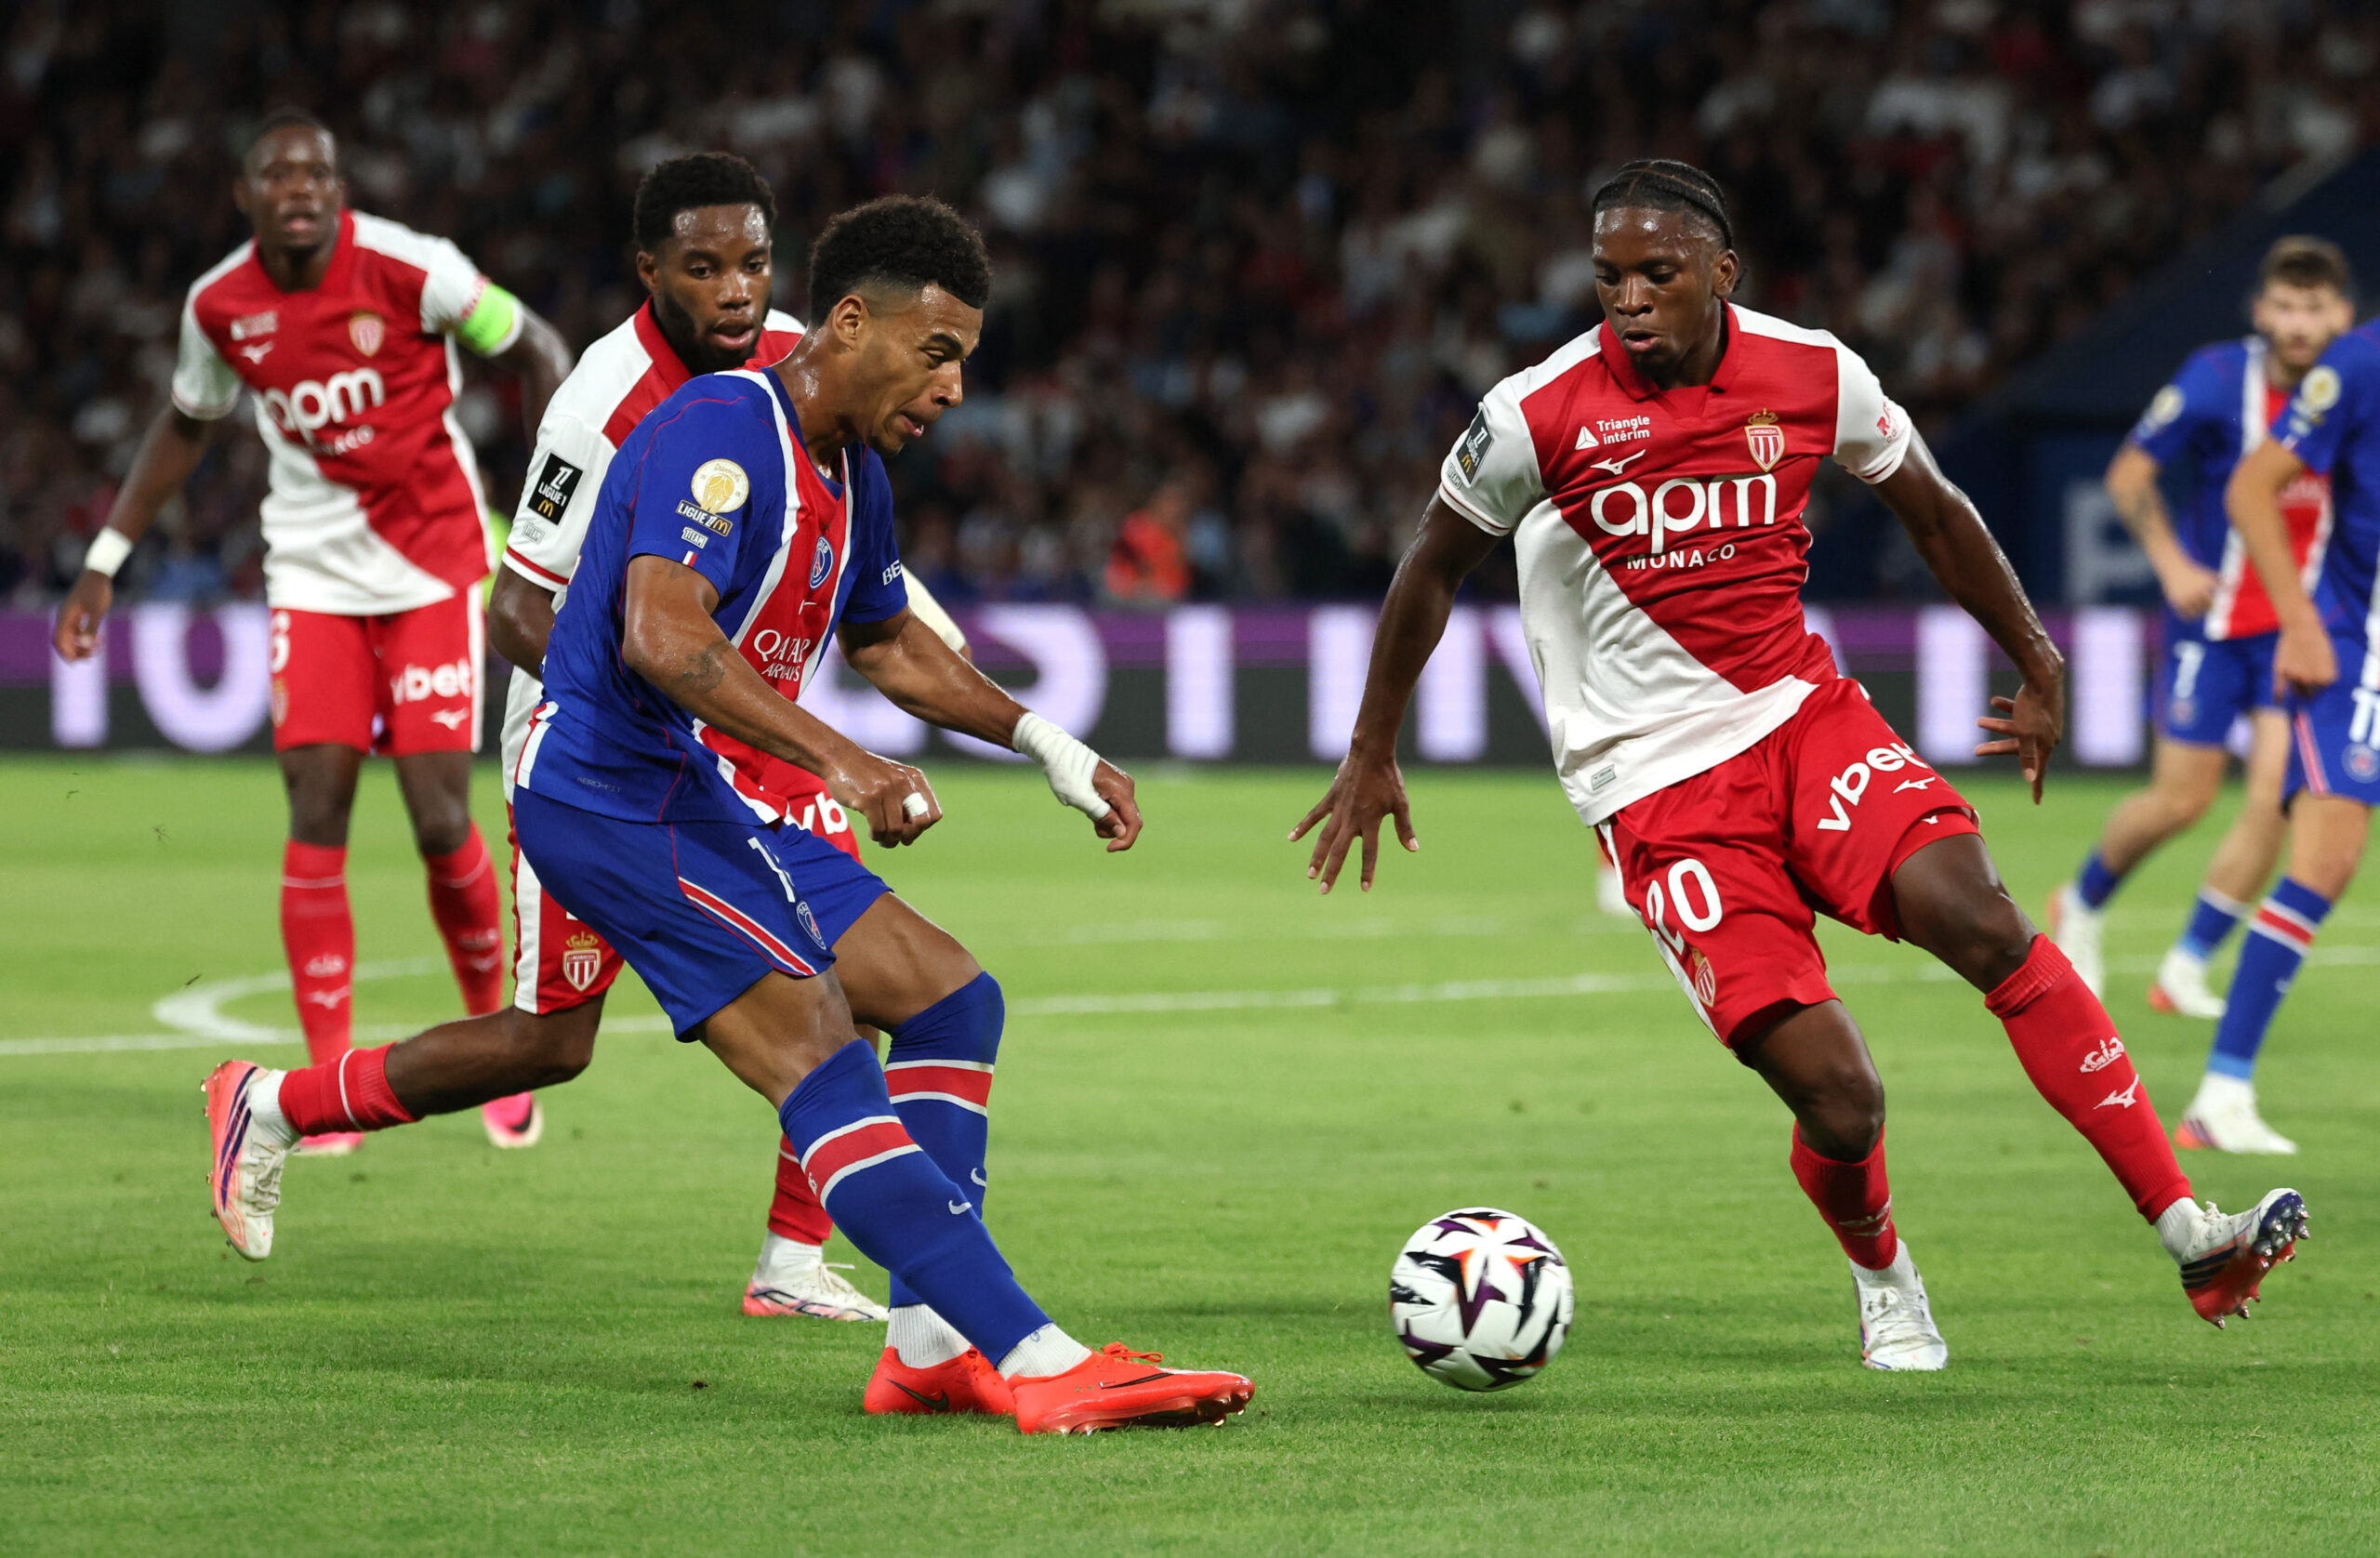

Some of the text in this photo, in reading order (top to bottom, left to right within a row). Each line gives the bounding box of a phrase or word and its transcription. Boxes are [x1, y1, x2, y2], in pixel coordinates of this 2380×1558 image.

[1596, 415, 1651, 432] Triangle
[1603, 429, 1651, 444] intérim
[538, 482, 567, 507] LIGUE 1
[677, 503, 708, 524] LIGUE
[1591, 473, 1777, 554] apm
[1627, 544, 1736, 570] MONACO
[754, 629, 811, 663] QATAR
[390, 658, 472, 706] vbet
[1817, 742, 1929, 831] vbet
[747, 837, 796, 904] 1
[1646, 858, 1723, 956] 20
